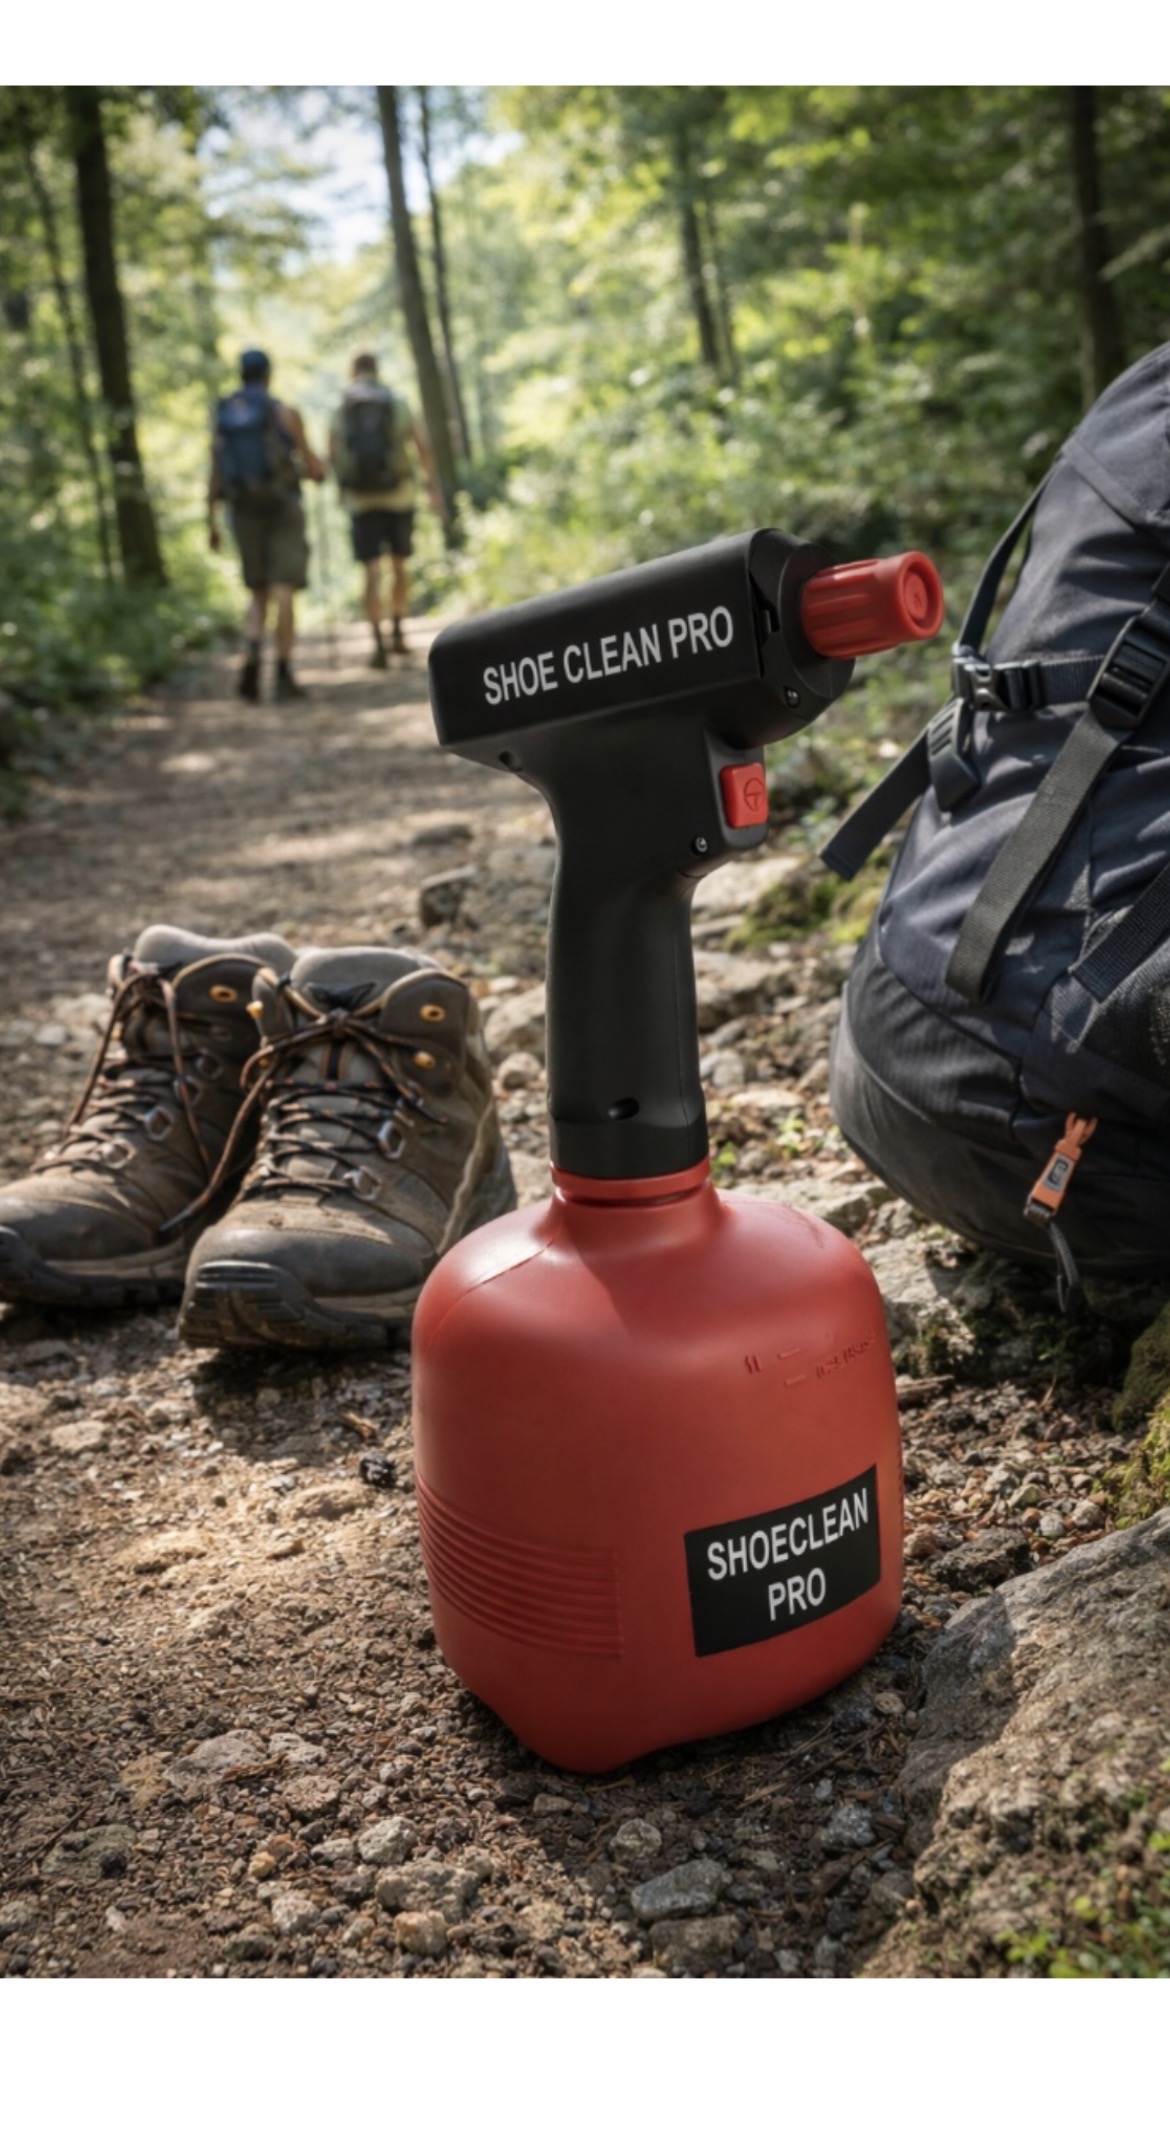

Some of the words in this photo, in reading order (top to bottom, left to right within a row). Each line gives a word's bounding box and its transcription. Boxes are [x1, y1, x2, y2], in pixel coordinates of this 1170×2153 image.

[482, 651, 559, 706] SHOE
[562, 623, 662, 685] CLEAN
[667, 605, 735, 660] PRO
[706, 1486, 870, 1582] SHOECLEAN
[767, 1566, 827, 1622] PRO
